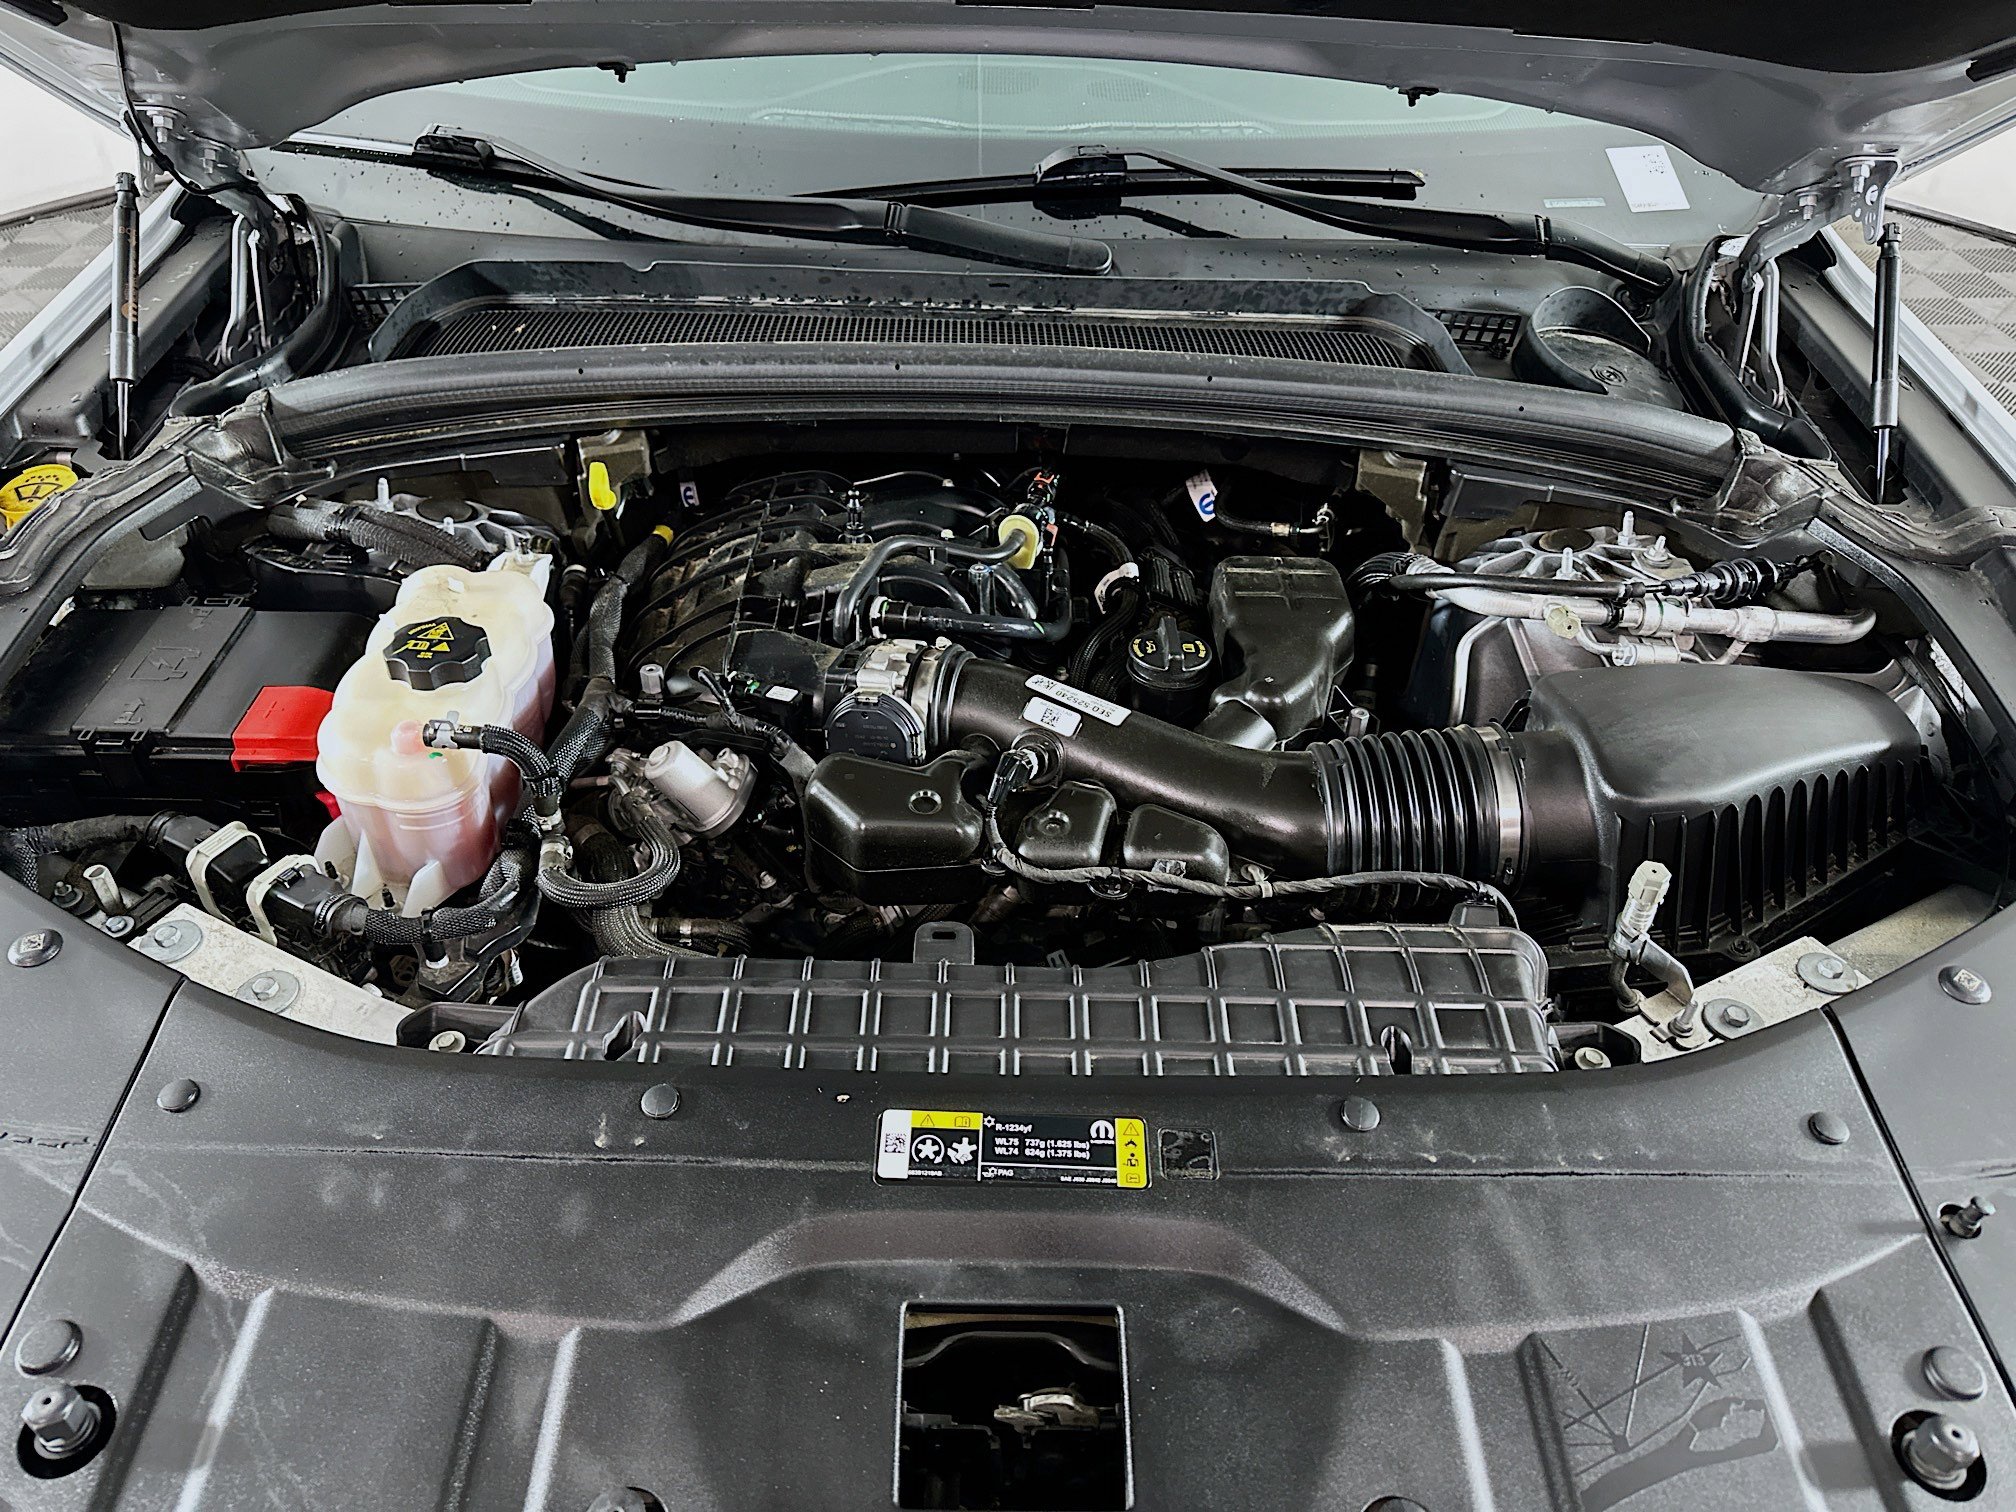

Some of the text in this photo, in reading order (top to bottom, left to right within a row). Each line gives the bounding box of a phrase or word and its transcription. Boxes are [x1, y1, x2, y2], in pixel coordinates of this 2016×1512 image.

[995, 1123, 1033, 1134] R-1234yf
[994, 1137, 1019, 1146] WL75
[1024, 1138, 1046, 1149] 737g
[1046, 1139, 1073, 1149] (1.625
[1073, 1140, 1090, 1151] lbs)
[994, 1146, 1091, 1160] WL74 624g (1.375 lbs)
[997, 1168, 1014, 1177] PAG
